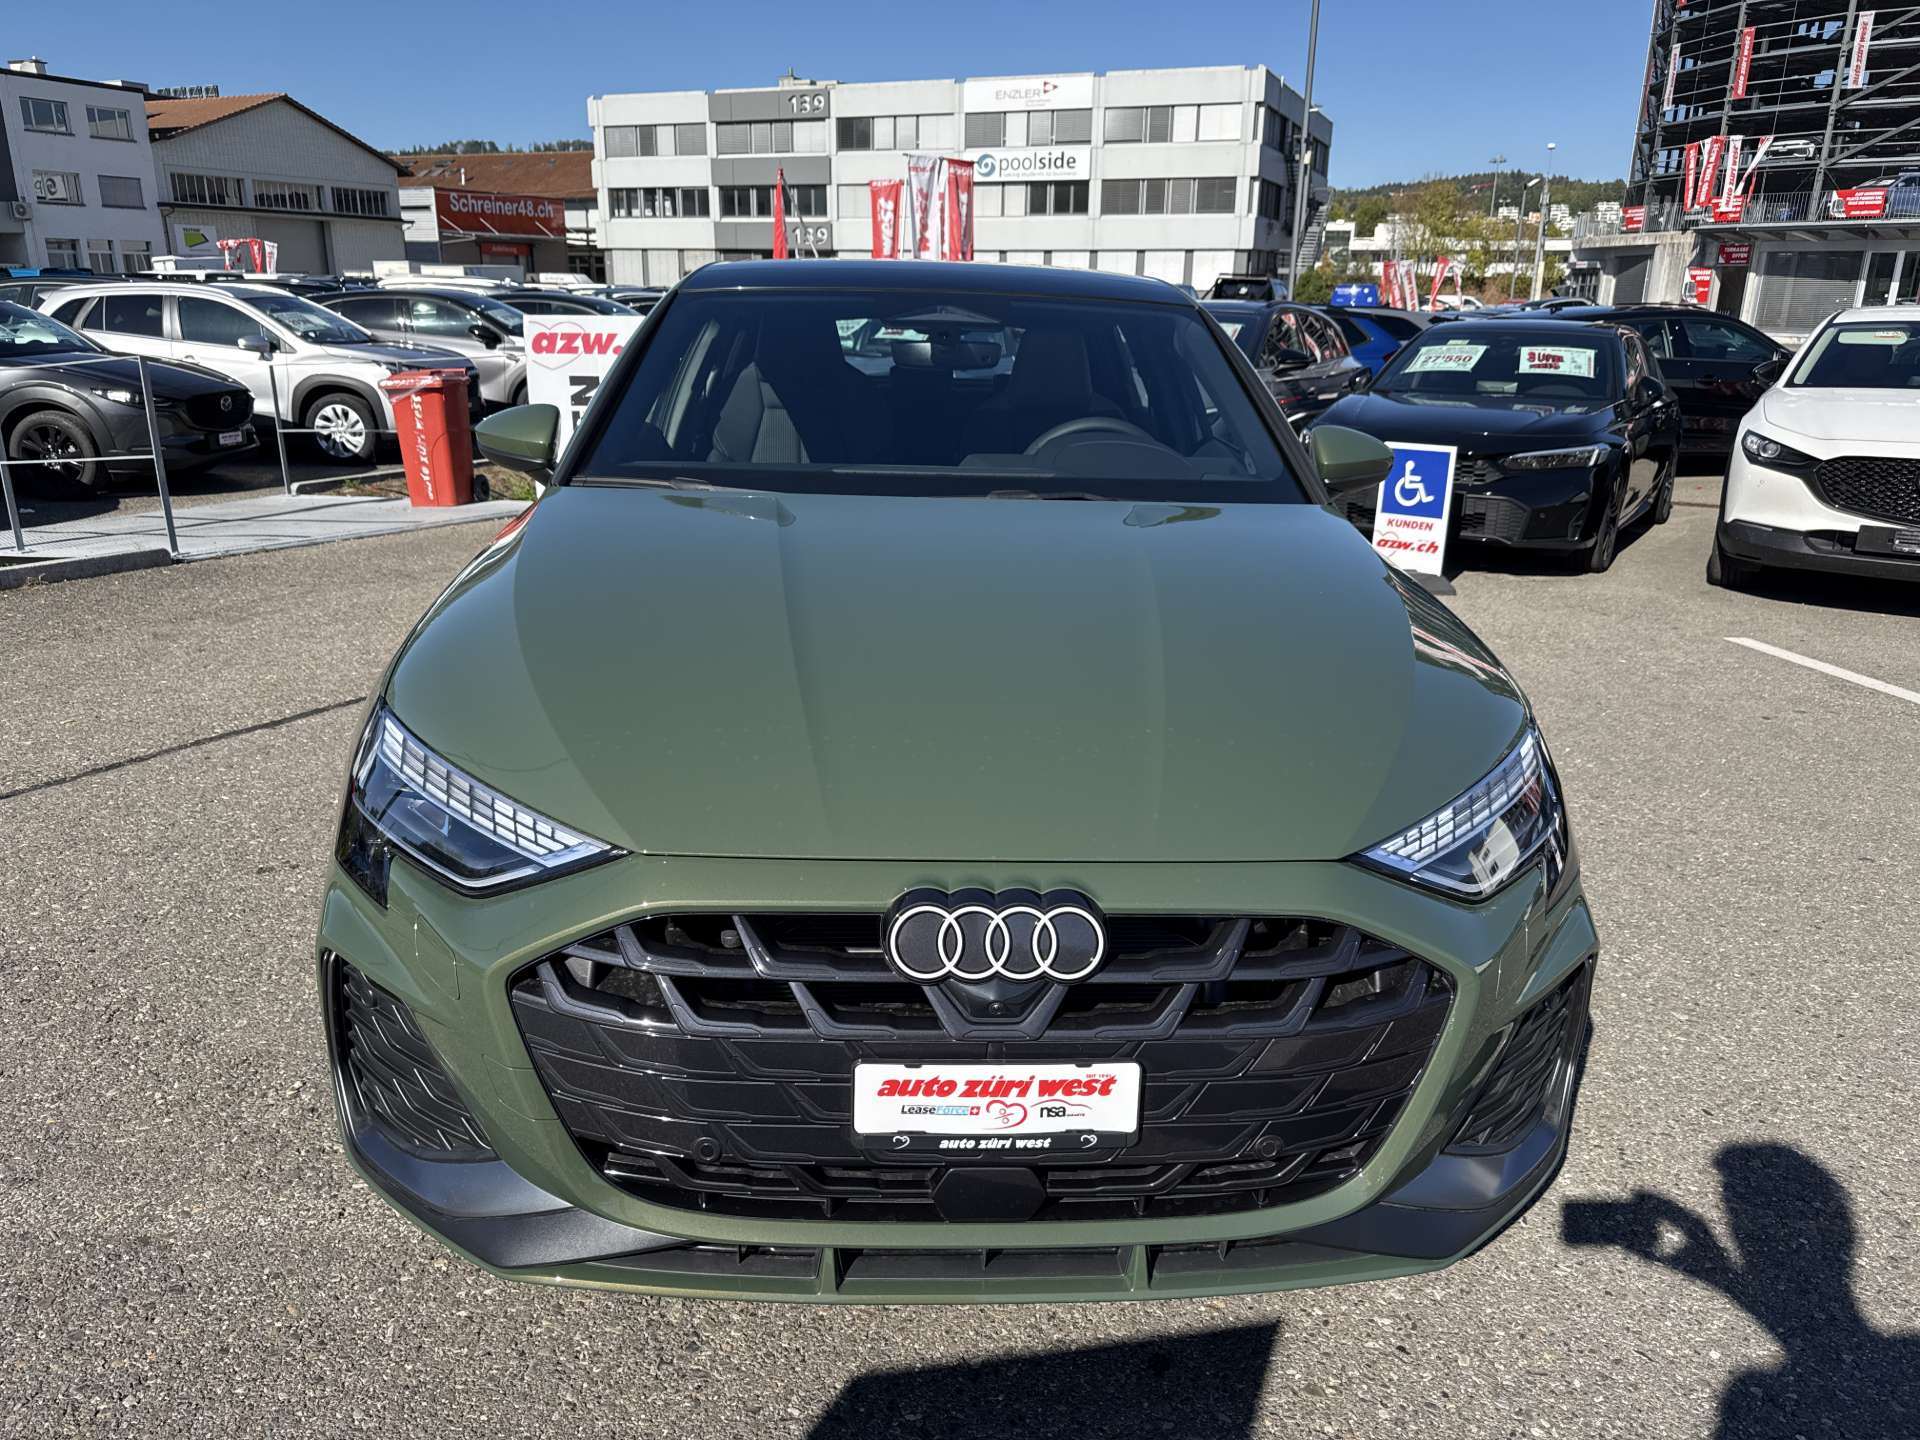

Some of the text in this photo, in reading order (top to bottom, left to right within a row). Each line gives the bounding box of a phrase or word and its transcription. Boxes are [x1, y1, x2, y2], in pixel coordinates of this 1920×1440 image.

[995, 88, 1041, 101] ENZLER
[789, 94, 825, 114] 139
[999, 151, 1076, 177] poolside
[449, 192, 554, 218] Schreiner48.ch
[792, 227, 828, 245] 139
[1386, 517, 1435, 532] KUNDEN
[1376, 537, 1439, 554] azw.ch
[877, 1074, 1118, 1098] auto züri west
[900, 1104, 969, 1116] LeaseForce
[1039, 1106, 1067, 1118] nsa
[939, 1137, 1052, 1149] auto züri west
